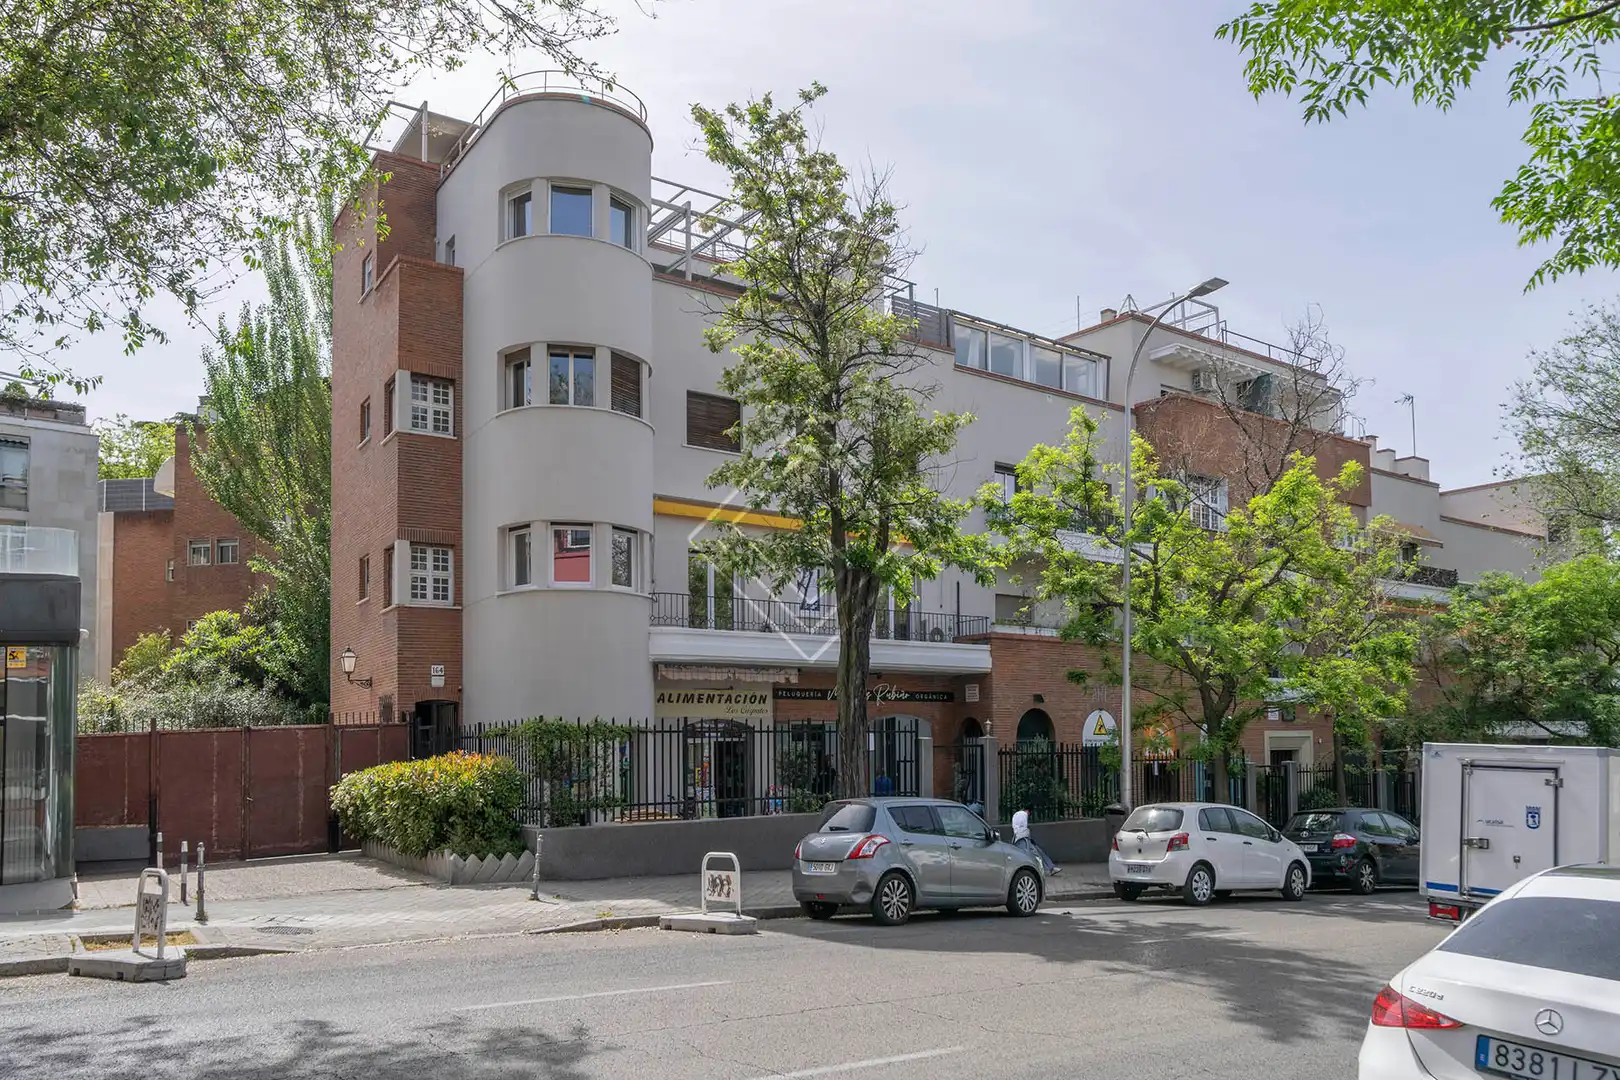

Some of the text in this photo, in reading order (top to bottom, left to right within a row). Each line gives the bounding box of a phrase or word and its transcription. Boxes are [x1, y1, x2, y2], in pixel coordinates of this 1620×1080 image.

[432, 666, 444, 674] 164
[657, 691, 768, 704] ALIMENTACIÓN
[1495, 1044, 1558, 1080] 8381
